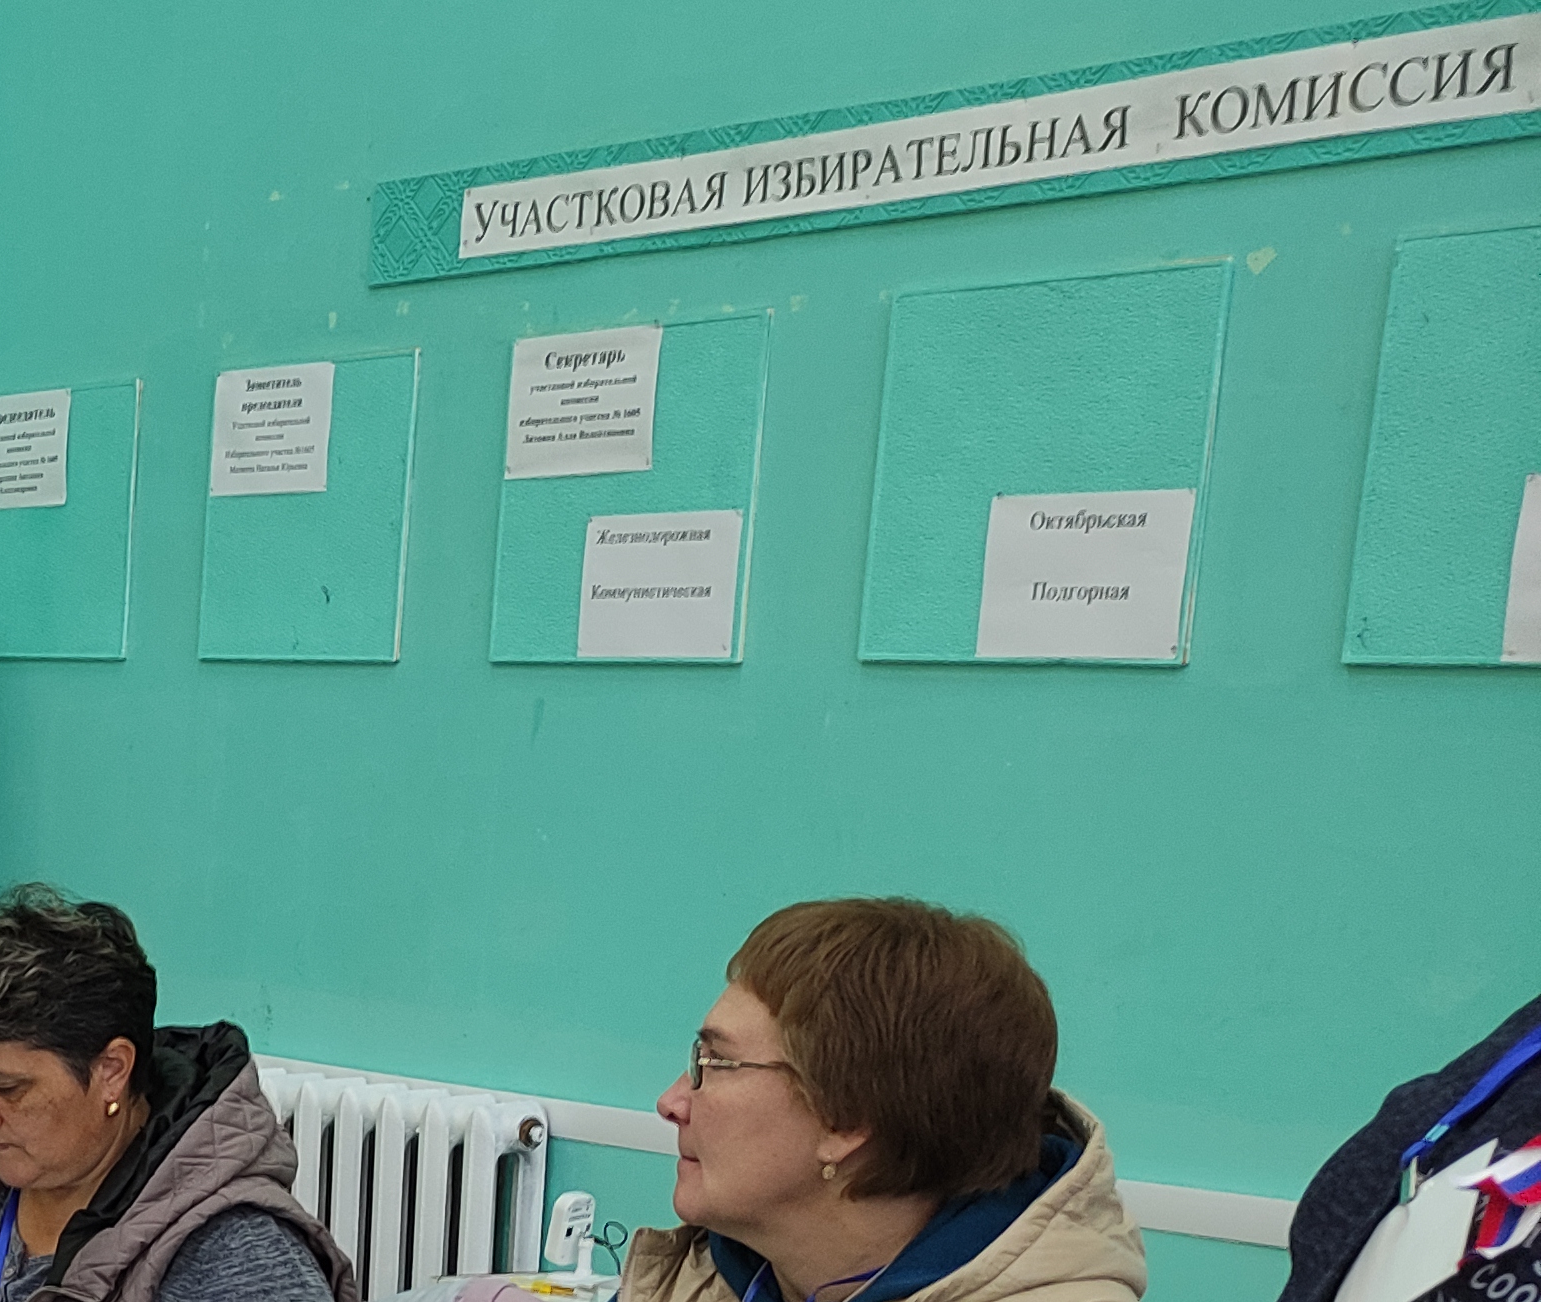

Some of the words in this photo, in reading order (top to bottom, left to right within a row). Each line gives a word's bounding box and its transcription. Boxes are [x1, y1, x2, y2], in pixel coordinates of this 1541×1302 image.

[474, 171, 728, 242] УЧАСТКОВАЯ
[743, 104, 1132, 206] ИЗБИРАТЕЛЬНАЯ
[1173, 42, 1519, 140] КОМИССИЯ
[544, 349, 626, 372] Секретарь
[1029, 509, 1148, 534] Октябрьская
[596, 529, 711, 546] Железнодорожная
[591, 584, 712, 602] Коммунистическая
[1030, 581, 1130, 605] Подгорная
